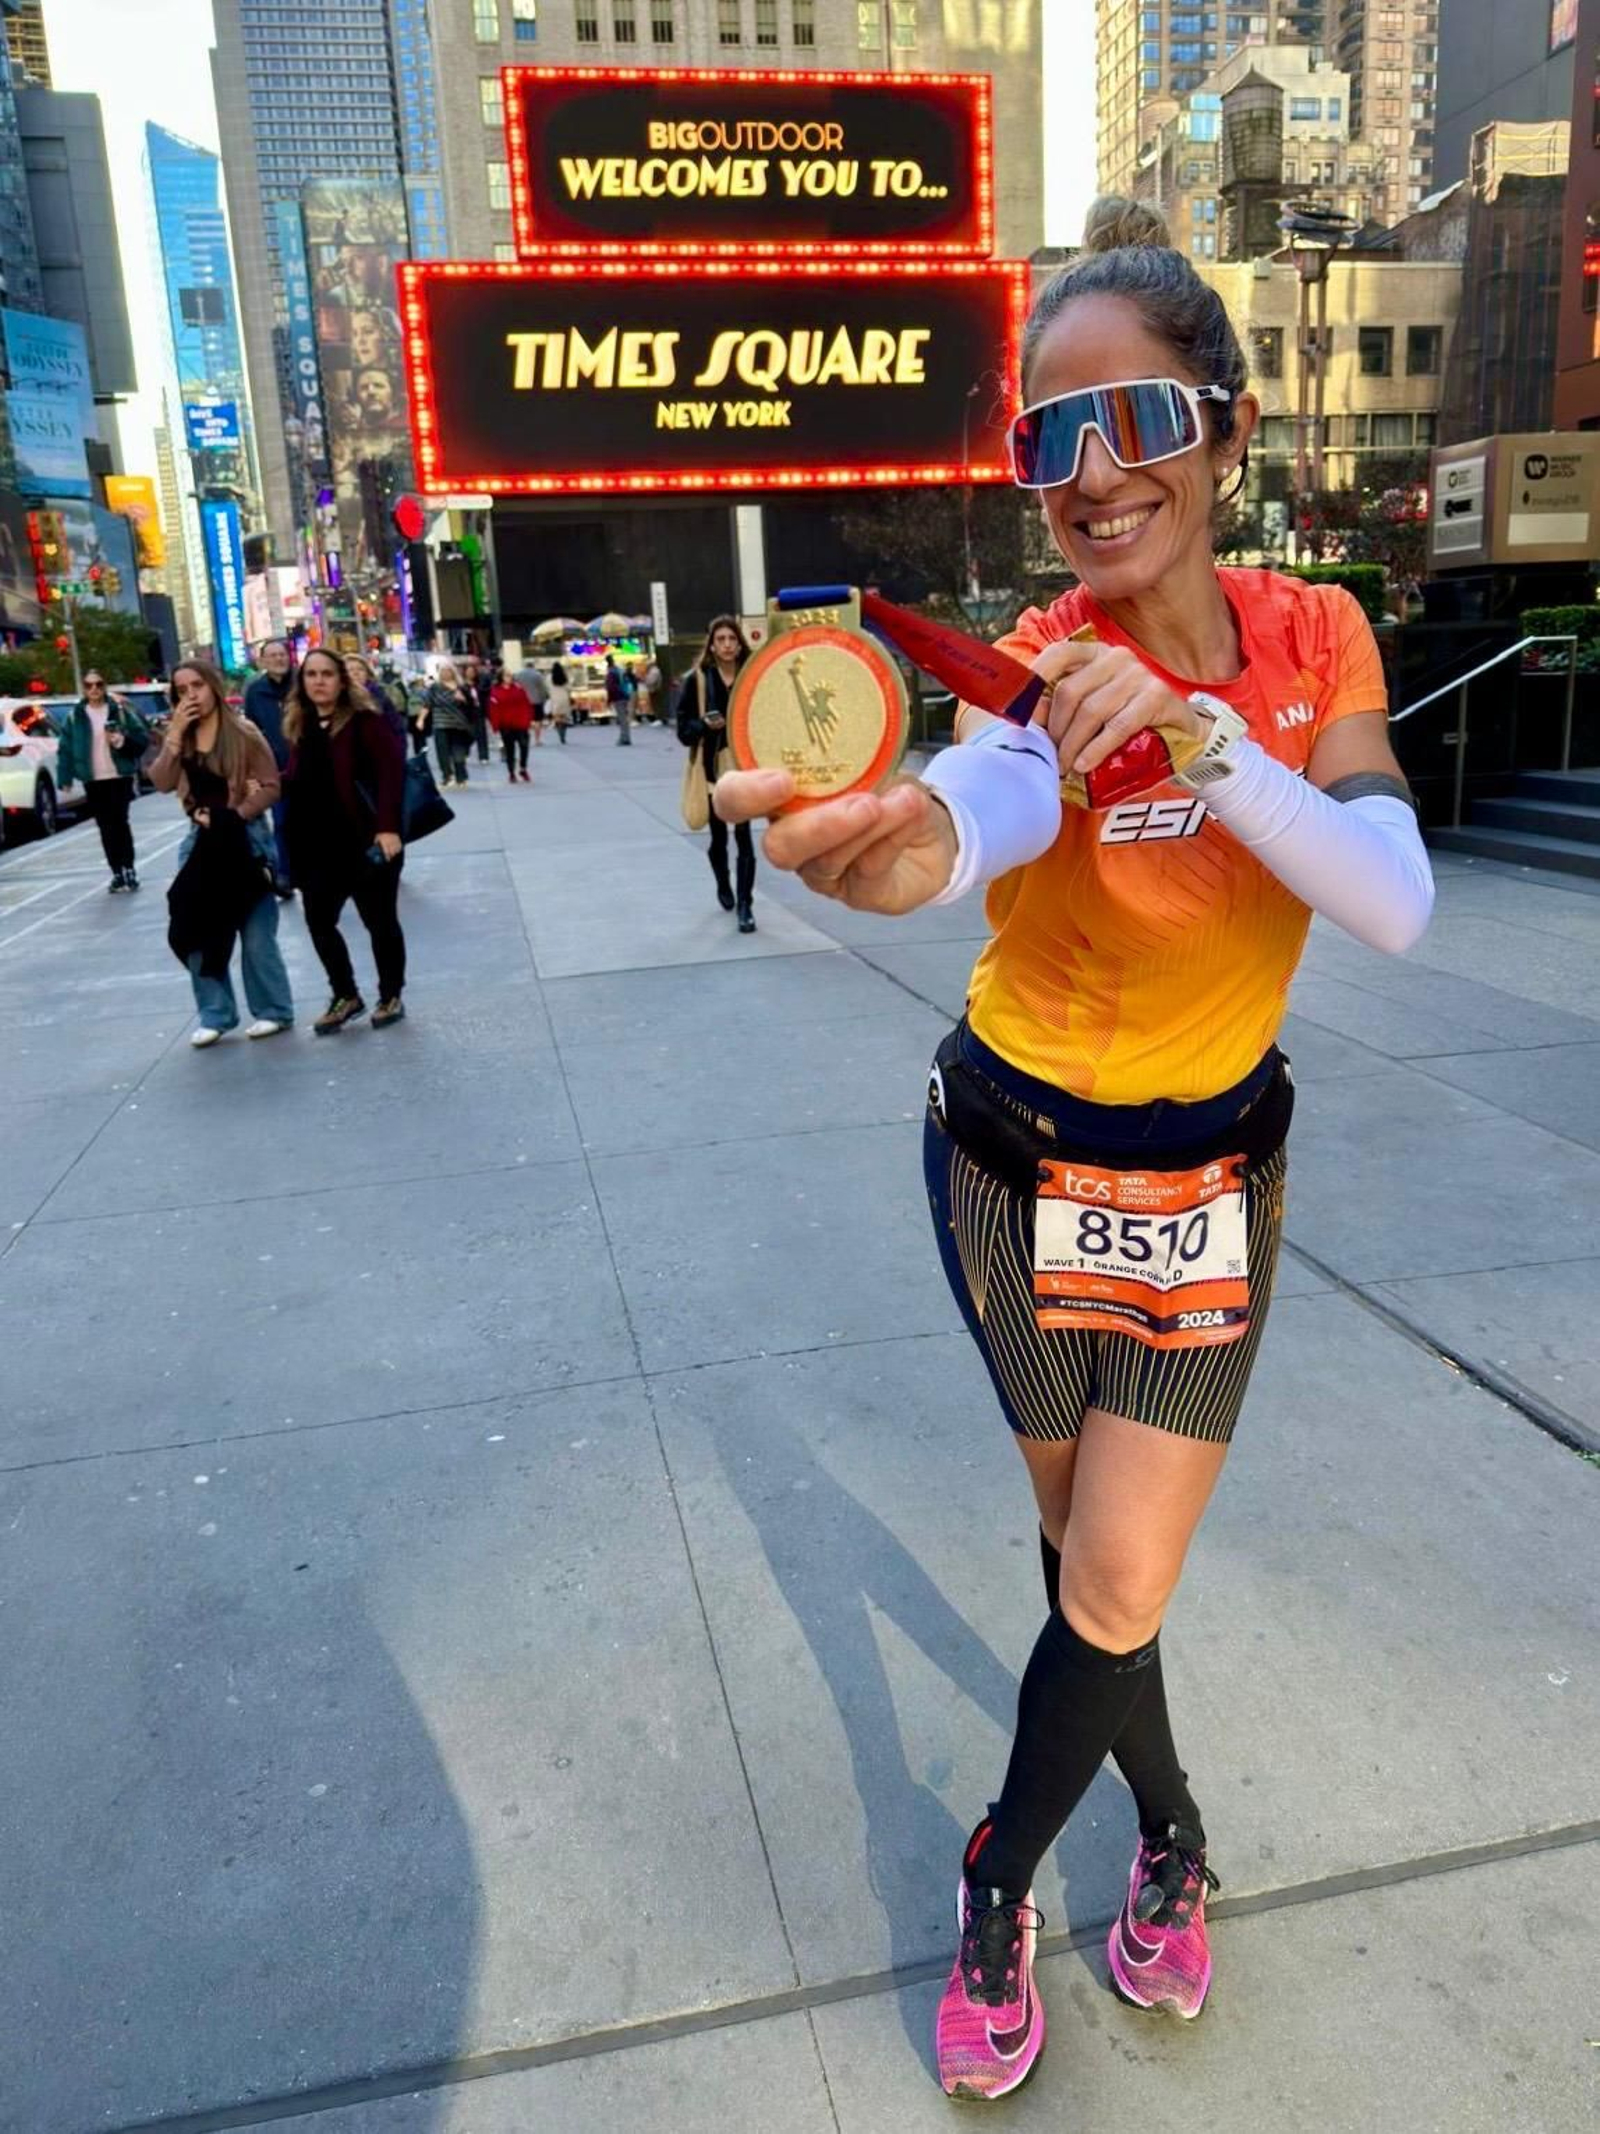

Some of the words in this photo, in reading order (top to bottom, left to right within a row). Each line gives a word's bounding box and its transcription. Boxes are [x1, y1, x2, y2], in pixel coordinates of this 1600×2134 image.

[648, 121, 844, 151] BIGOUTDOOR
[560, 156, 768, 199] WELCOMES
[780, 159, 859, 197] YOU
[870, 160, 948, 198] TO...
[284, 215, 309, 322] TIMES
[506, 326, 680, 390] TIMES
[694, 324, 931, 391] SQUARE
[655, 401, 719, 429] NEW
[722, 400, 792, 428] YORK
[1065, 1168, 1112, 1201] tcs
[1118, 1176, 1148, 1186] TATA
[1117, 1196, 1162, 1206] SERVICES
[1076, 1209, 1210, 1271] 8510
[1044, 1258, 1074, 1268] WAVE
[1077, 1257, 1085, 1269] 1
[1094, 1261, 1138, 1275] ORANGE
[1173, 1269, 1183, 1281] D
[1177, 1309, 1226, 1329] 2024
